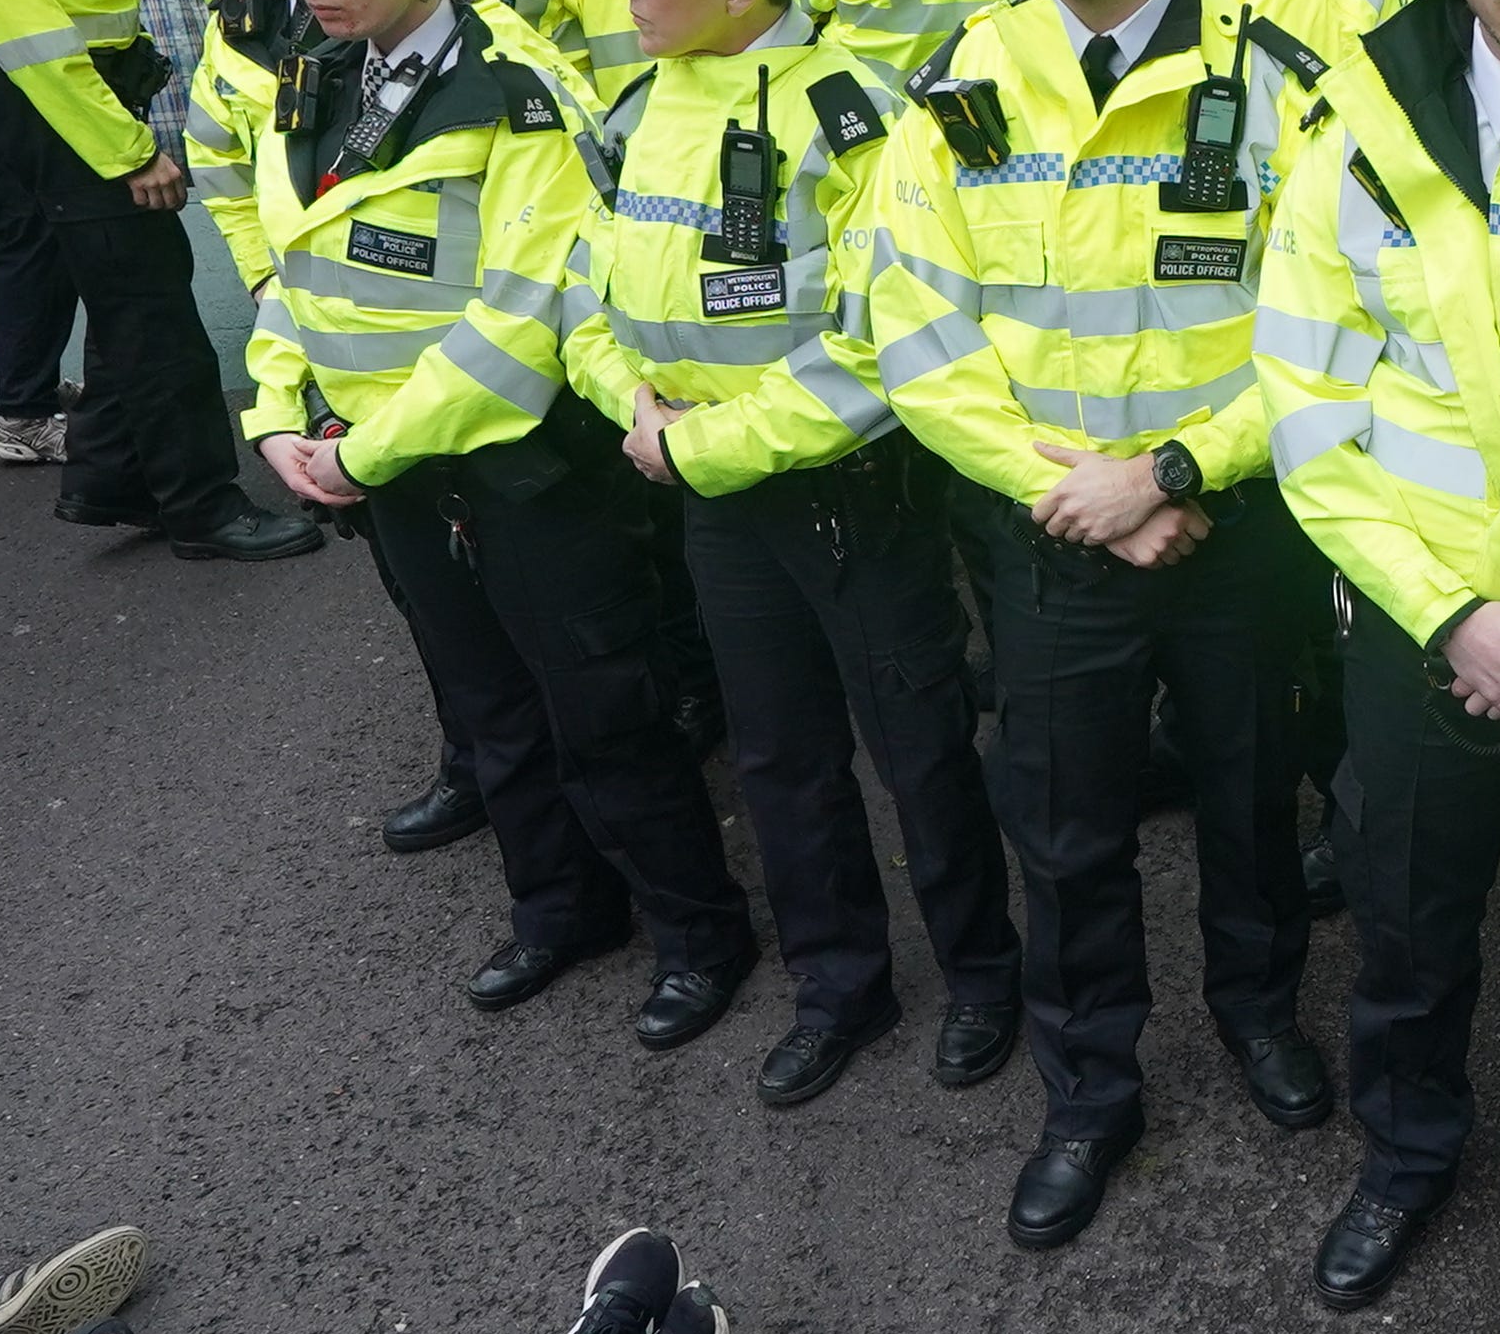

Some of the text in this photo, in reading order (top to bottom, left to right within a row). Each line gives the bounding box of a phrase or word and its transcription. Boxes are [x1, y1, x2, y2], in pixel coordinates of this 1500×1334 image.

[526, 98, 544, 110] AS
[524, 111, 553, 124] 2905
[839, 111, 858, 127] AS
[841, 123, 868, 141] 3316
[383, 242, 417, 255] POLICE
[1186, 245, 1238, 254] METROPOLITAN
[352, 247, 428, 271] POLICE OFFICER
[1191, 253, 1230, 262] POLICE
[1160, 264, 1237, 277] POLICE OFFICER
[733, 282, 772, 292] POLICE
[707, 293, 781, 311] POLICE OFFICER
